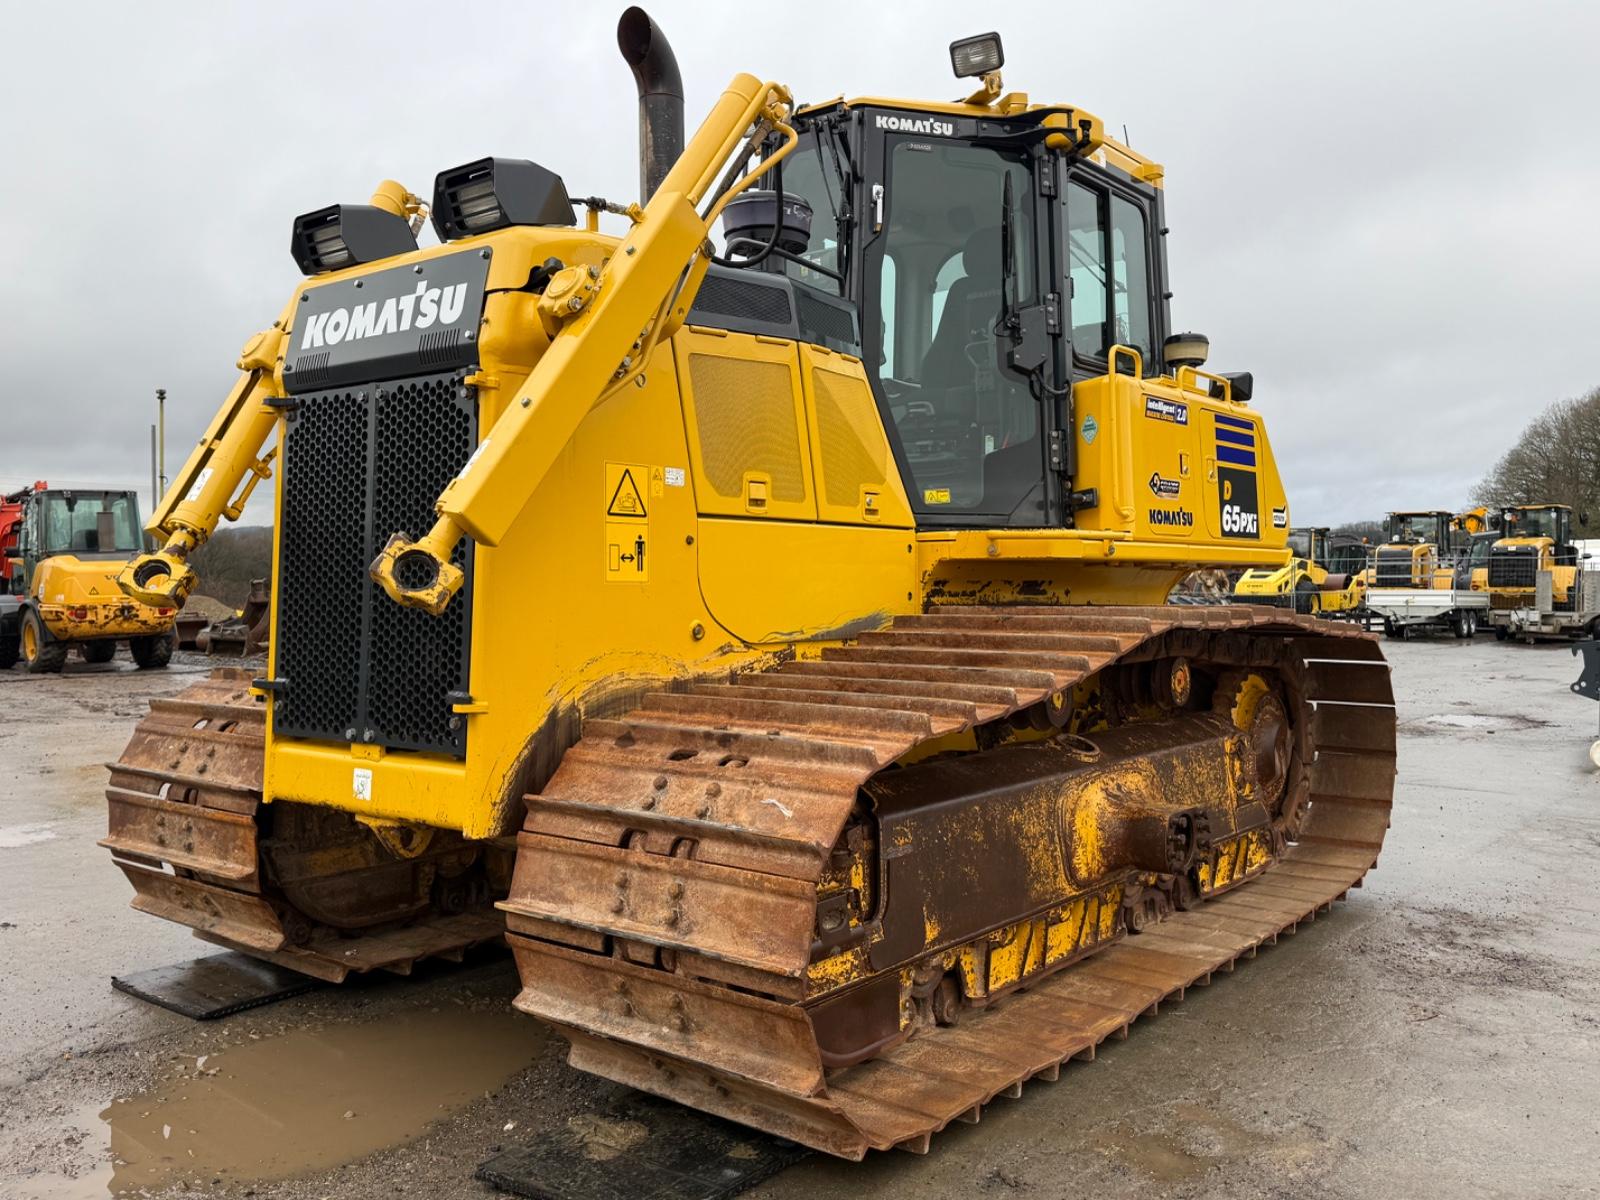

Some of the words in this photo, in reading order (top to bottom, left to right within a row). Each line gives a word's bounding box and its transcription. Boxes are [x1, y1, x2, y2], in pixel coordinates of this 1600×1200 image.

[875, 115, 953, 136] KOMATSU
[301, 280, 467, 350] KOMATSU
[1177, 408, 1186, 422] 2.0
[1223, 480, 1232, 500] D
[1149, 507, 1193, 526] KOMATSU
[1222, 504, 1257, 533] 65PXi
